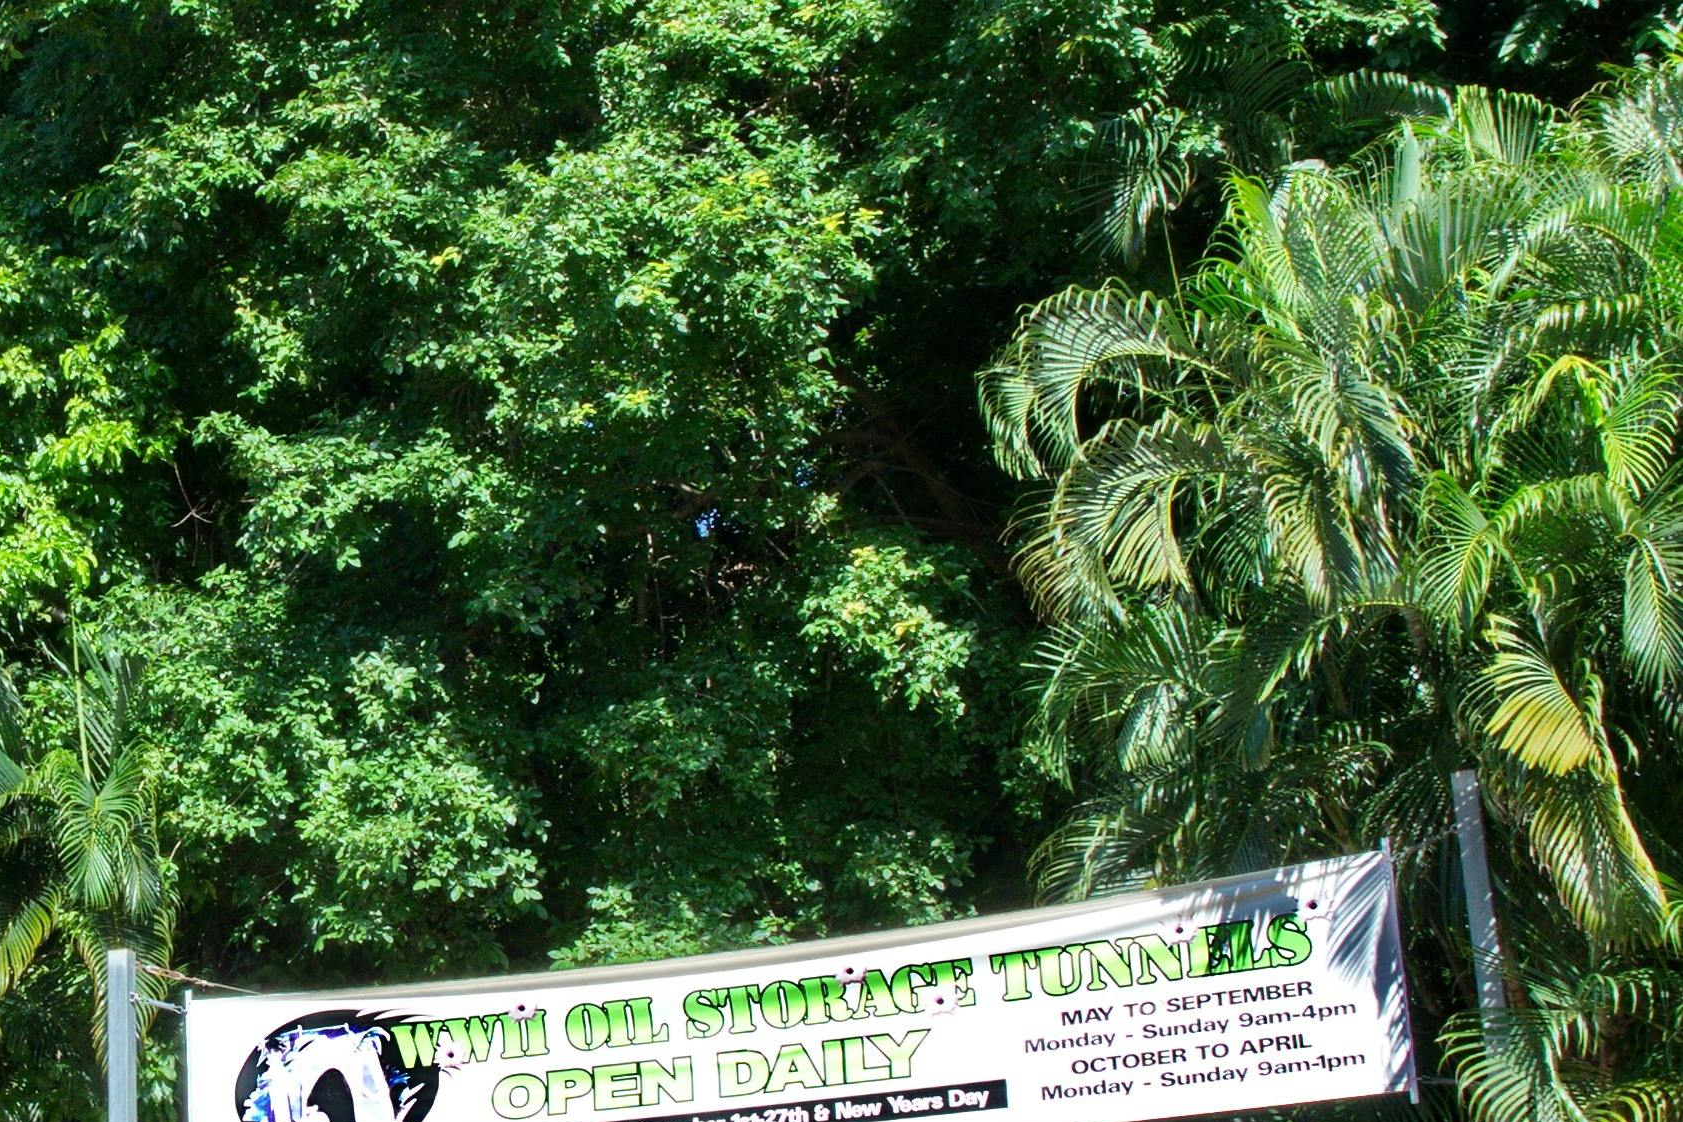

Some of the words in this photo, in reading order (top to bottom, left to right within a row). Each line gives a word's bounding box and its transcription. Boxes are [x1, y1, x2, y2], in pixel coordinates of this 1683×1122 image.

[390, 1009, 550, 1069] WWII
[565, 996, 670, 1051] OIL
[682, 958, 977, 1040] STORAGE
[989, 912, 1314, 1002] TUNNELS
[1061, 1006, 1114, 1026] MAY
[1122, 1000, 1157, 1019] TO
[1165, 980, 1314, 1014] SEPTEMBER
[1024, 1030, 1116, 1054] Monday
[1142, 1016, 1230, 1041] Sunday
[1239, 1001, 1357, 1028] 9am-4pm
[491, 1055, 694, 1120] OPEN
[716, 1028, 932, 1098] DAILY
[1041, 1079, 1134, 1101] Monday
[1160, 1065, 1250, 1089] Sunday
[1258, 1050, 1367, 1077] 9am-1pm
[1071, 1047, 1188, 1076] OCTOBER
[1195, 1041, 1230, 1060] TO
[1239, 1032, 1313, 1056] APRIL
[813, 1104, 831, 1122] &
[834, 1099, 882, 1121] New
[886, 1093, 945, 1115] Years
[947, 1087, 990, 1110] Day
